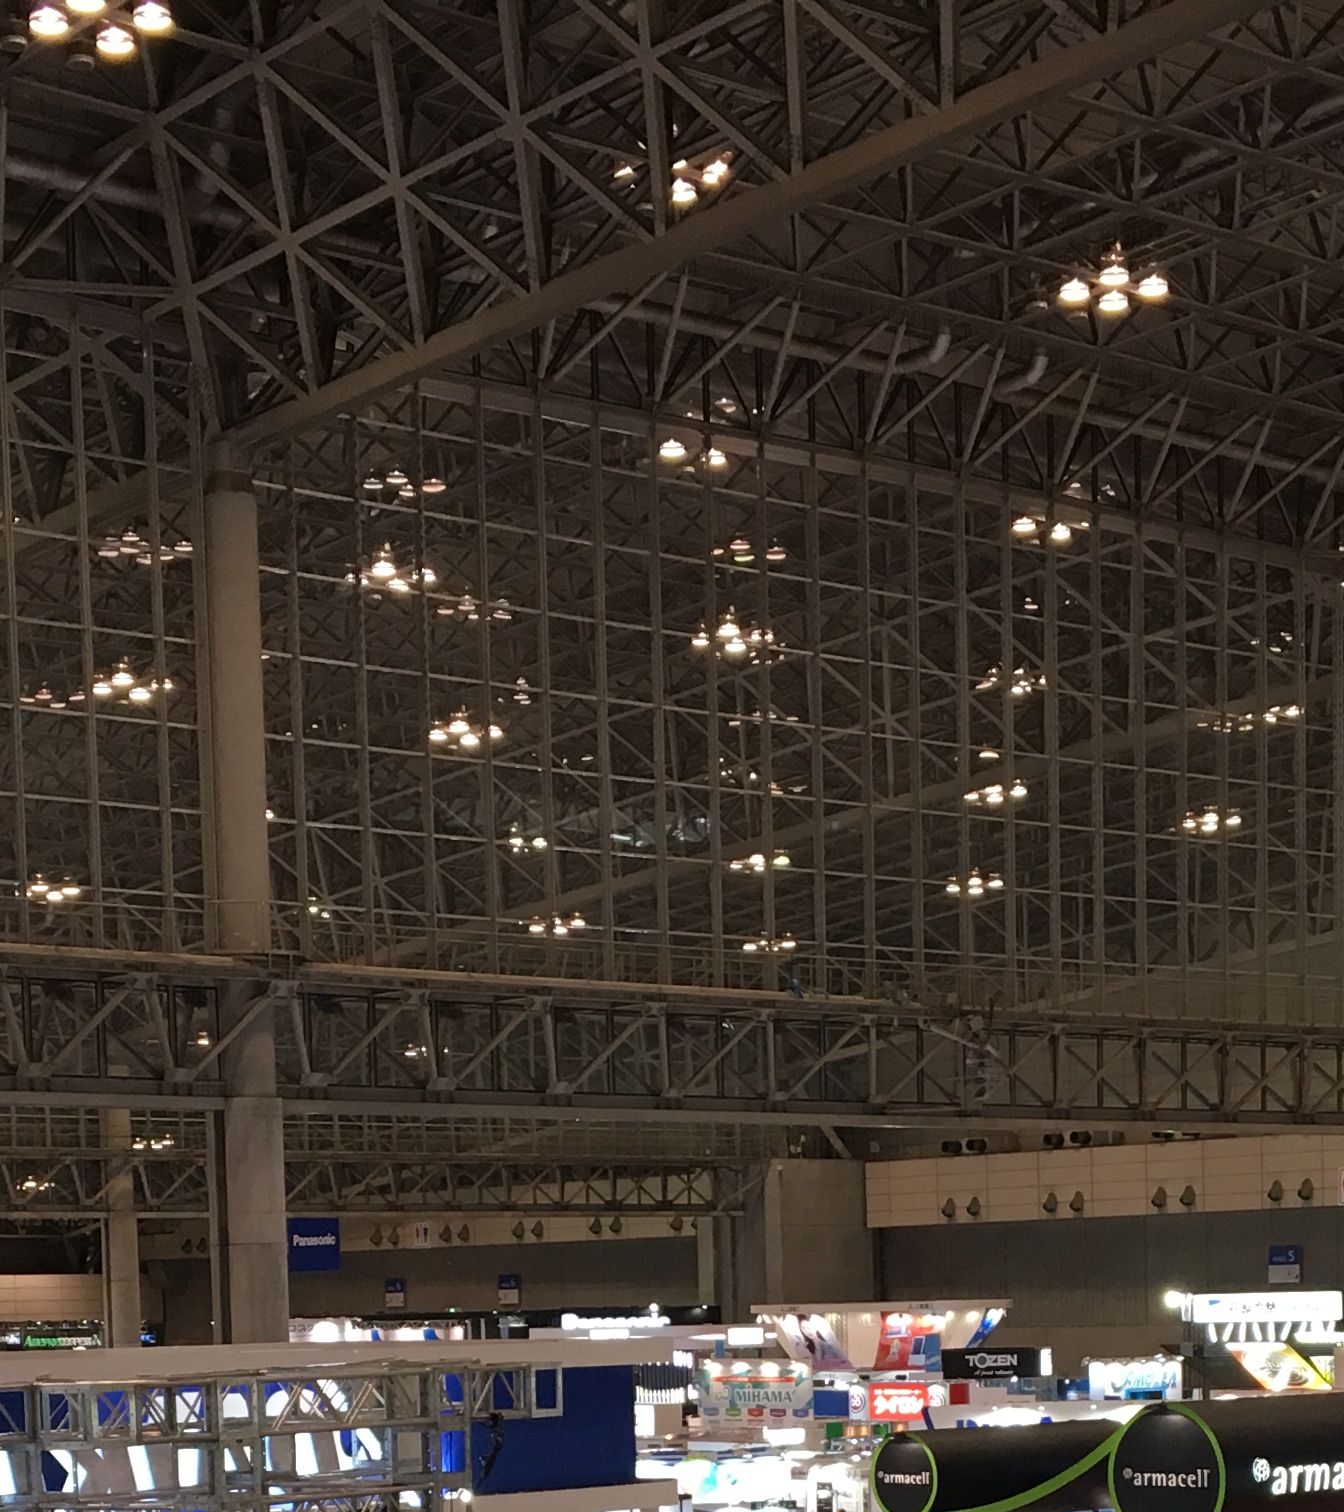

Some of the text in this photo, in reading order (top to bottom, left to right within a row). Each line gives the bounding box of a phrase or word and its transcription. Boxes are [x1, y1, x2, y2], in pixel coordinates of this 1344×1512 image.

[293, 1233, 337, 1247] Panasonic
[1288, 1251, 1295, 1262] 5
[964, 1353, 1017, 1368] TOZEN
[734, 1389, 792, 1402] MIHAMA
[883, 1471, 930, 1485] armacell
[1133, 1468, 1210, 1489] armacell
